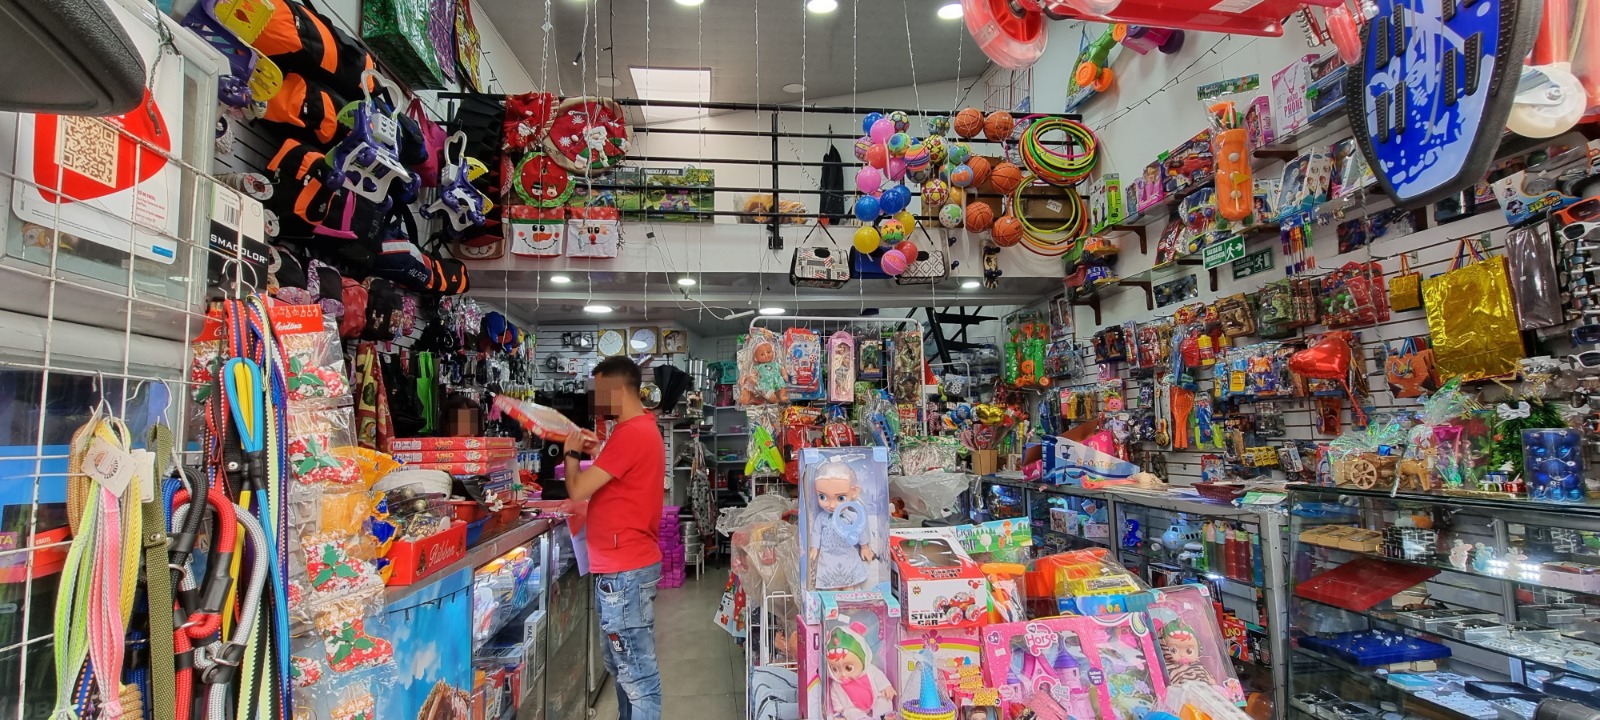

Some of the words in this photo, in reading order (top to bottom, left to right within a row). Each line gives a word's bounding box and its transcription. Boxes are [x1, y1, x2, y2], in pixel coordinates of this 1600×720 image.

[210, 233, 266, 264] SMACOLOR
[911, 612, 945, 620] STUNT
[1224, 627, 1241, 637] UNO
[1025, 633, 1057, 645] Horse
